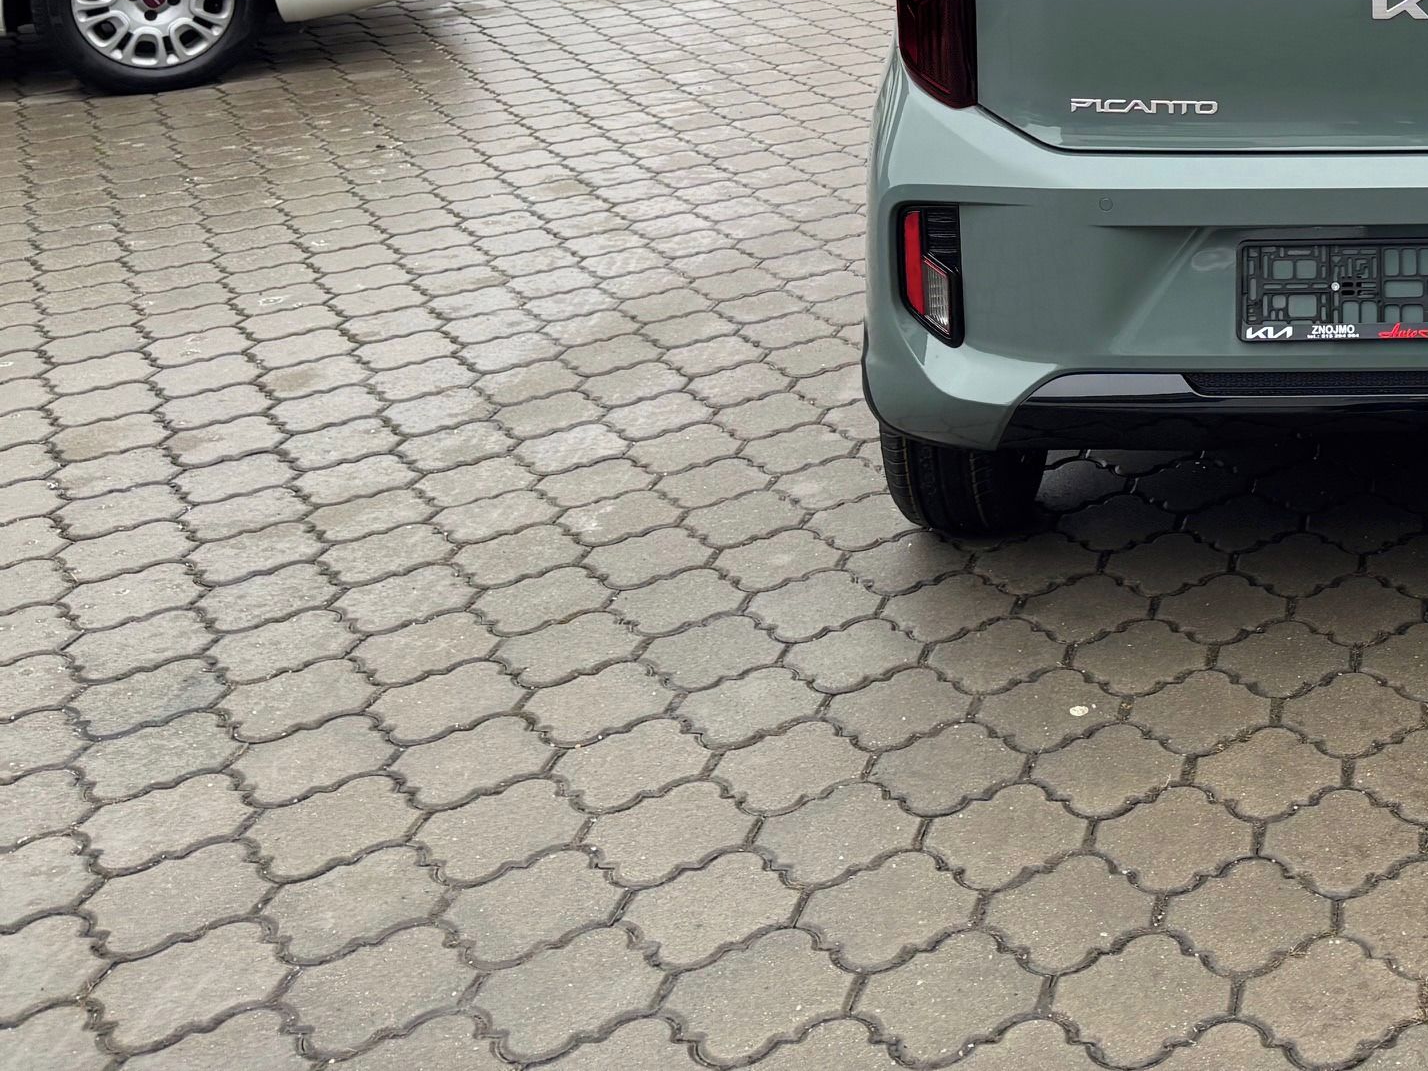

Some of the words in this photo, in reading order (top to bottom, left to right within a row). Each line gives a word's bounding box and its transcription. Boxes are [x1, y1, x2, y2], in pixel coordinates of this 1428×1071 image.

[1070, 98, 1219, 116] PICANTO
[1246, 326, 1294, 339] KIA
[1311, 324, 1356, 335] ZNOJMO
